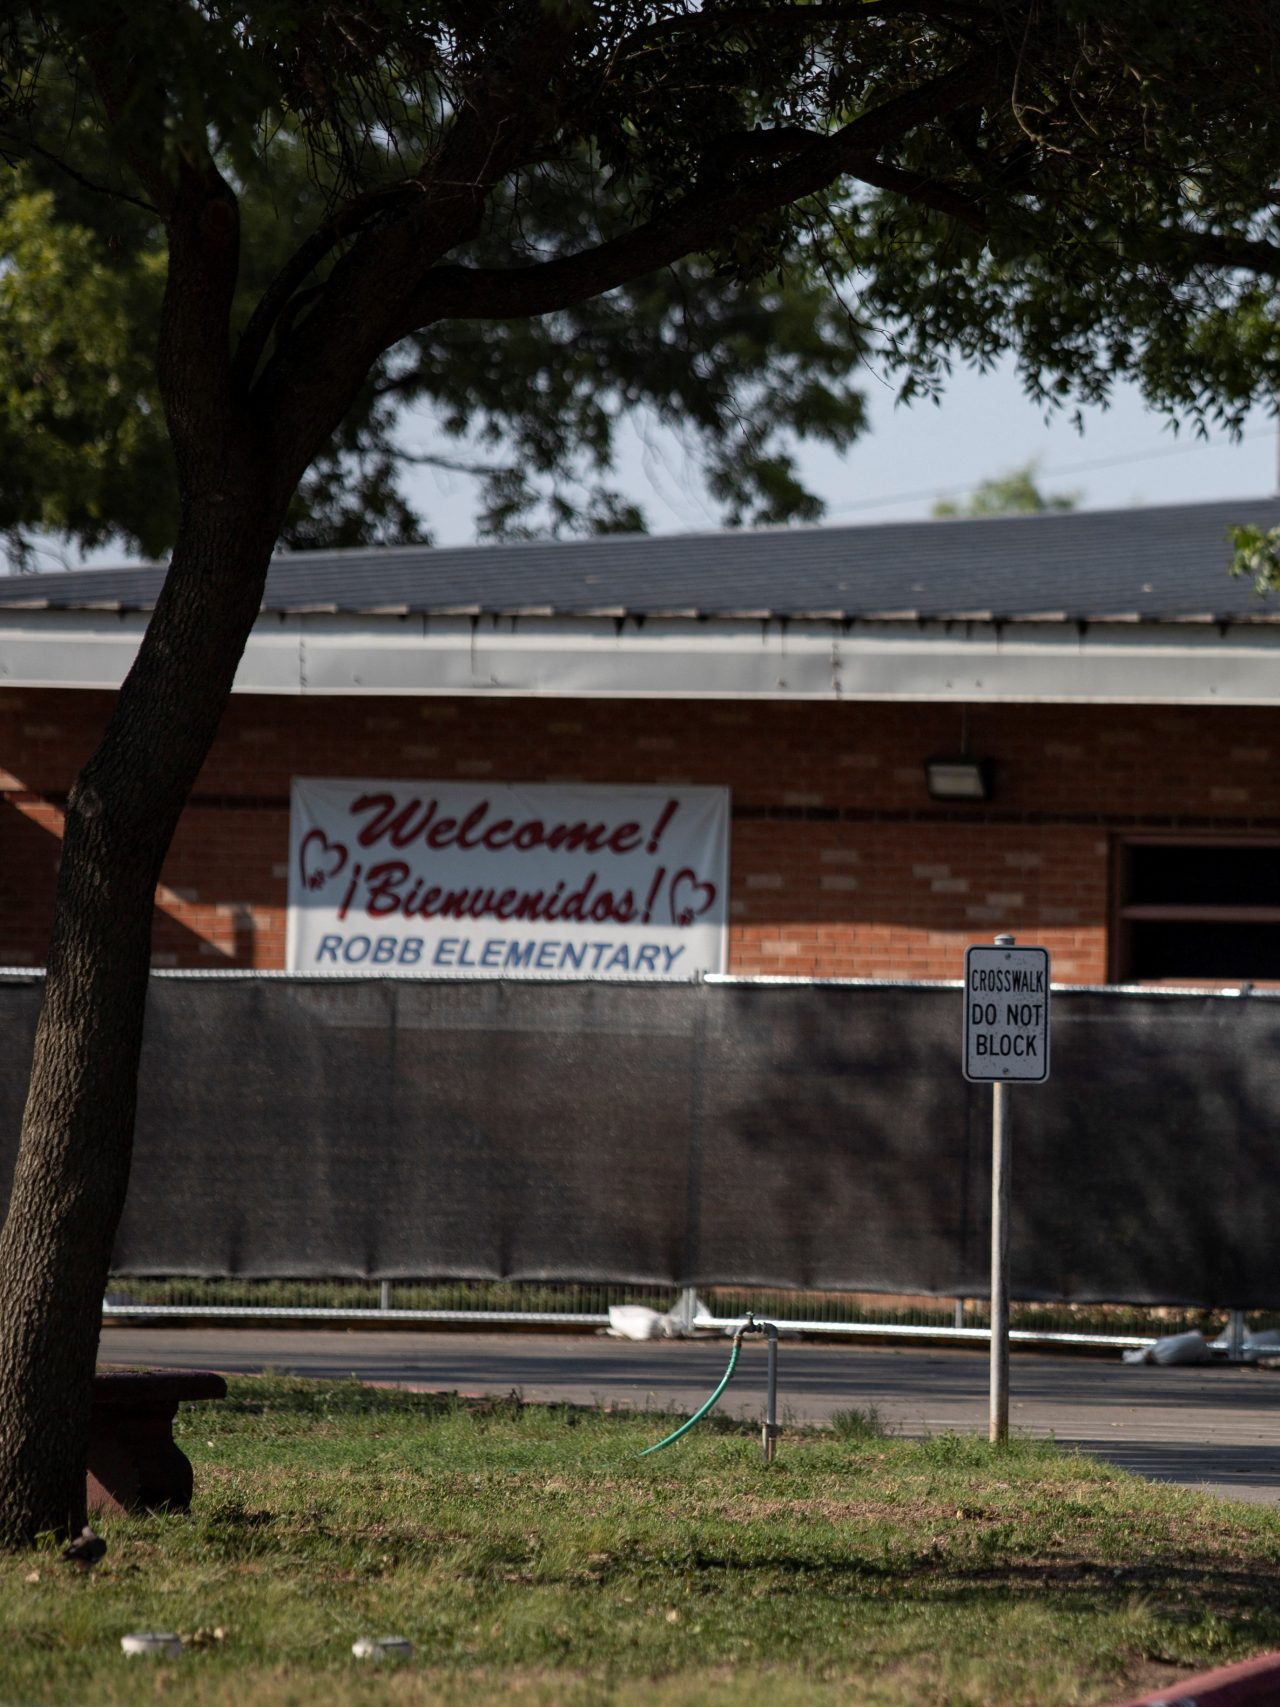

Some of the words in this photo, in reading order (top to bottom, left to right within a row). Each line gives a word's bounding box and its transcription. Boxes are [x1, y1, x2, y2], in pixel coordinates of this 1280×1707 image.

[349, 793, 680, 855] Welcome!
[337, 861, 667, 925] ¡Bienvenidos!
[315, 934, 425, 965] ROBB
[432, 937, 686, 973] ELEMENTARY
[971, 969, 1044, 993] CROSSWALK
[972, 1003, 997, 1025] DO
[1007, 1004, 1043, 1026] NOT
[976, 1034, 1038, 1056] BLOCK
